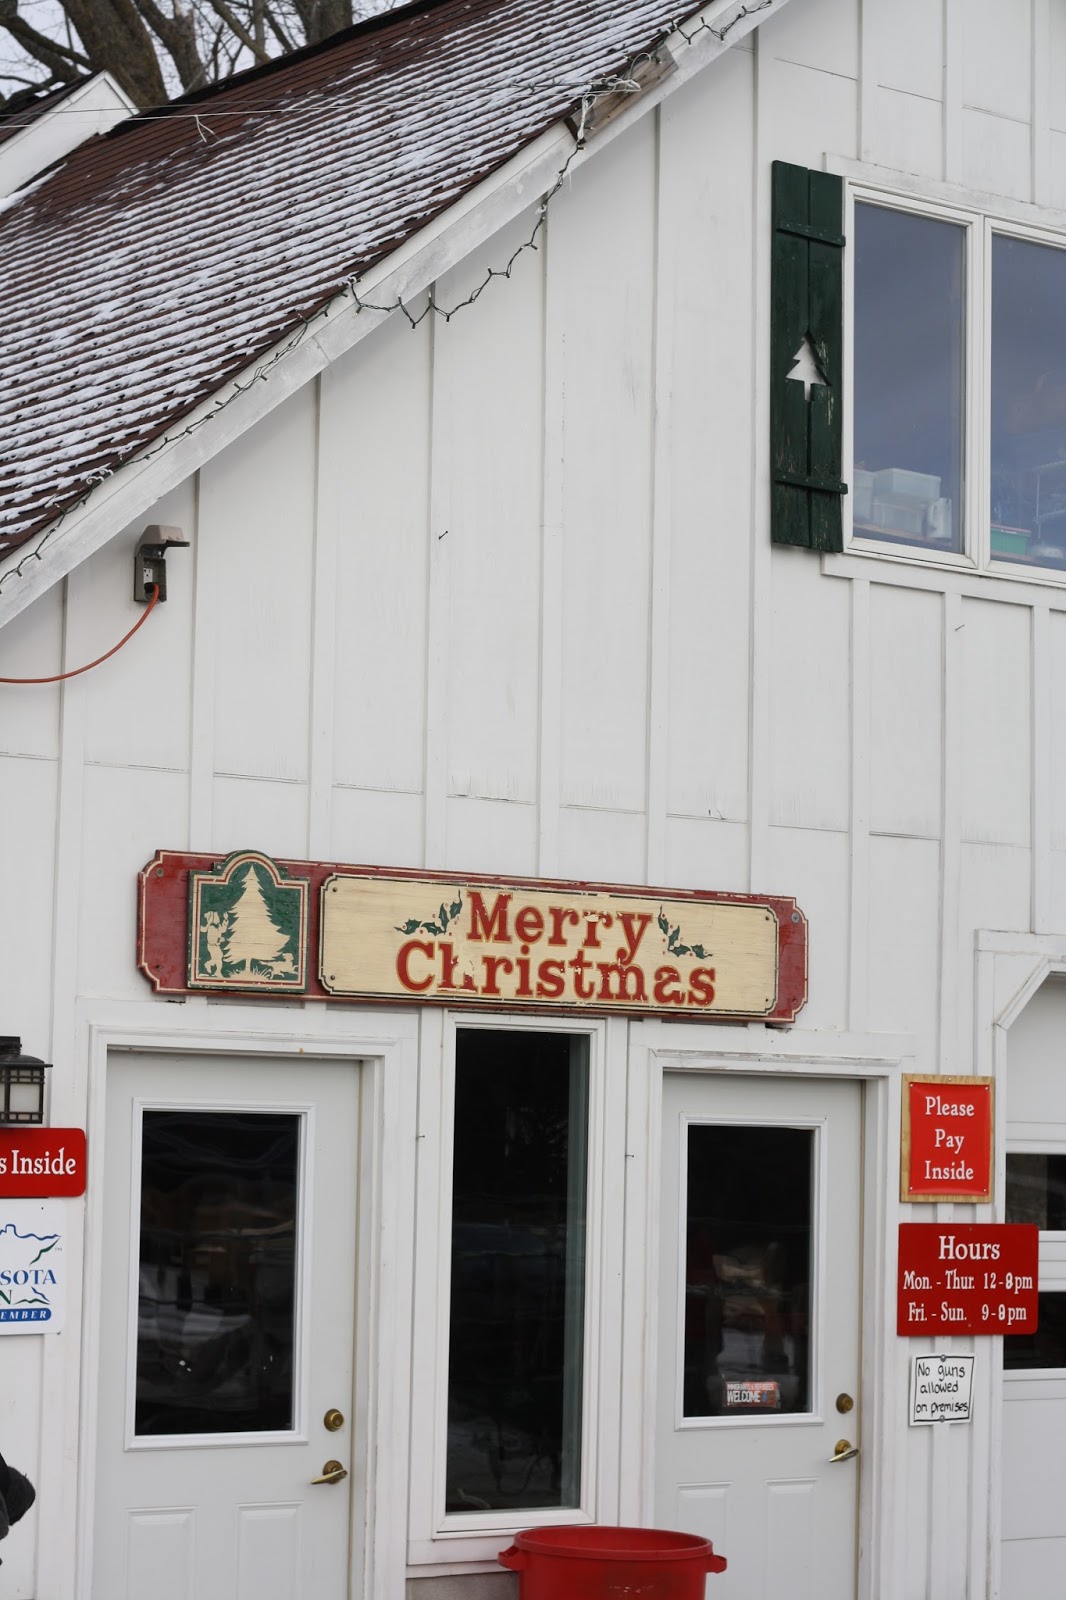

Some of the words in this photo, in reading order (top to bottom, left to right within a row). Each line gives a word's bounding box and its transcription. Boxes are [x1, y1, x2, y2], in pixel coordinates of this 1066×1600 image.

[466, 889, 653, 965] Merry
[395, 939, 717, 1007] Christmas
[925, 1095, 975, 1117] Please
[935, 1128, 965, 1155] Pay
[11, 1147, 77, 1176] Inside
[924, 1160, 974, 1180] Inside
[938, 1235, 1001, 1260] Hours
[903, 1270, 933, 1290] Mon.
[945, 1268, 975, 1290] Thur.
[908, 1302, 928, 1321] Fri.
[940, 1301, 967, 1321] Sun.
[917, 1362, 931, 1377] No
[937, 1365, 966, 1382] guns
[727, 1390, 761, 1403] WELCOME
[919, 1380, 959, 1394] allowed
[915, 1403, 928, 1413] on
[930, 1397, 969, 1418] premises
